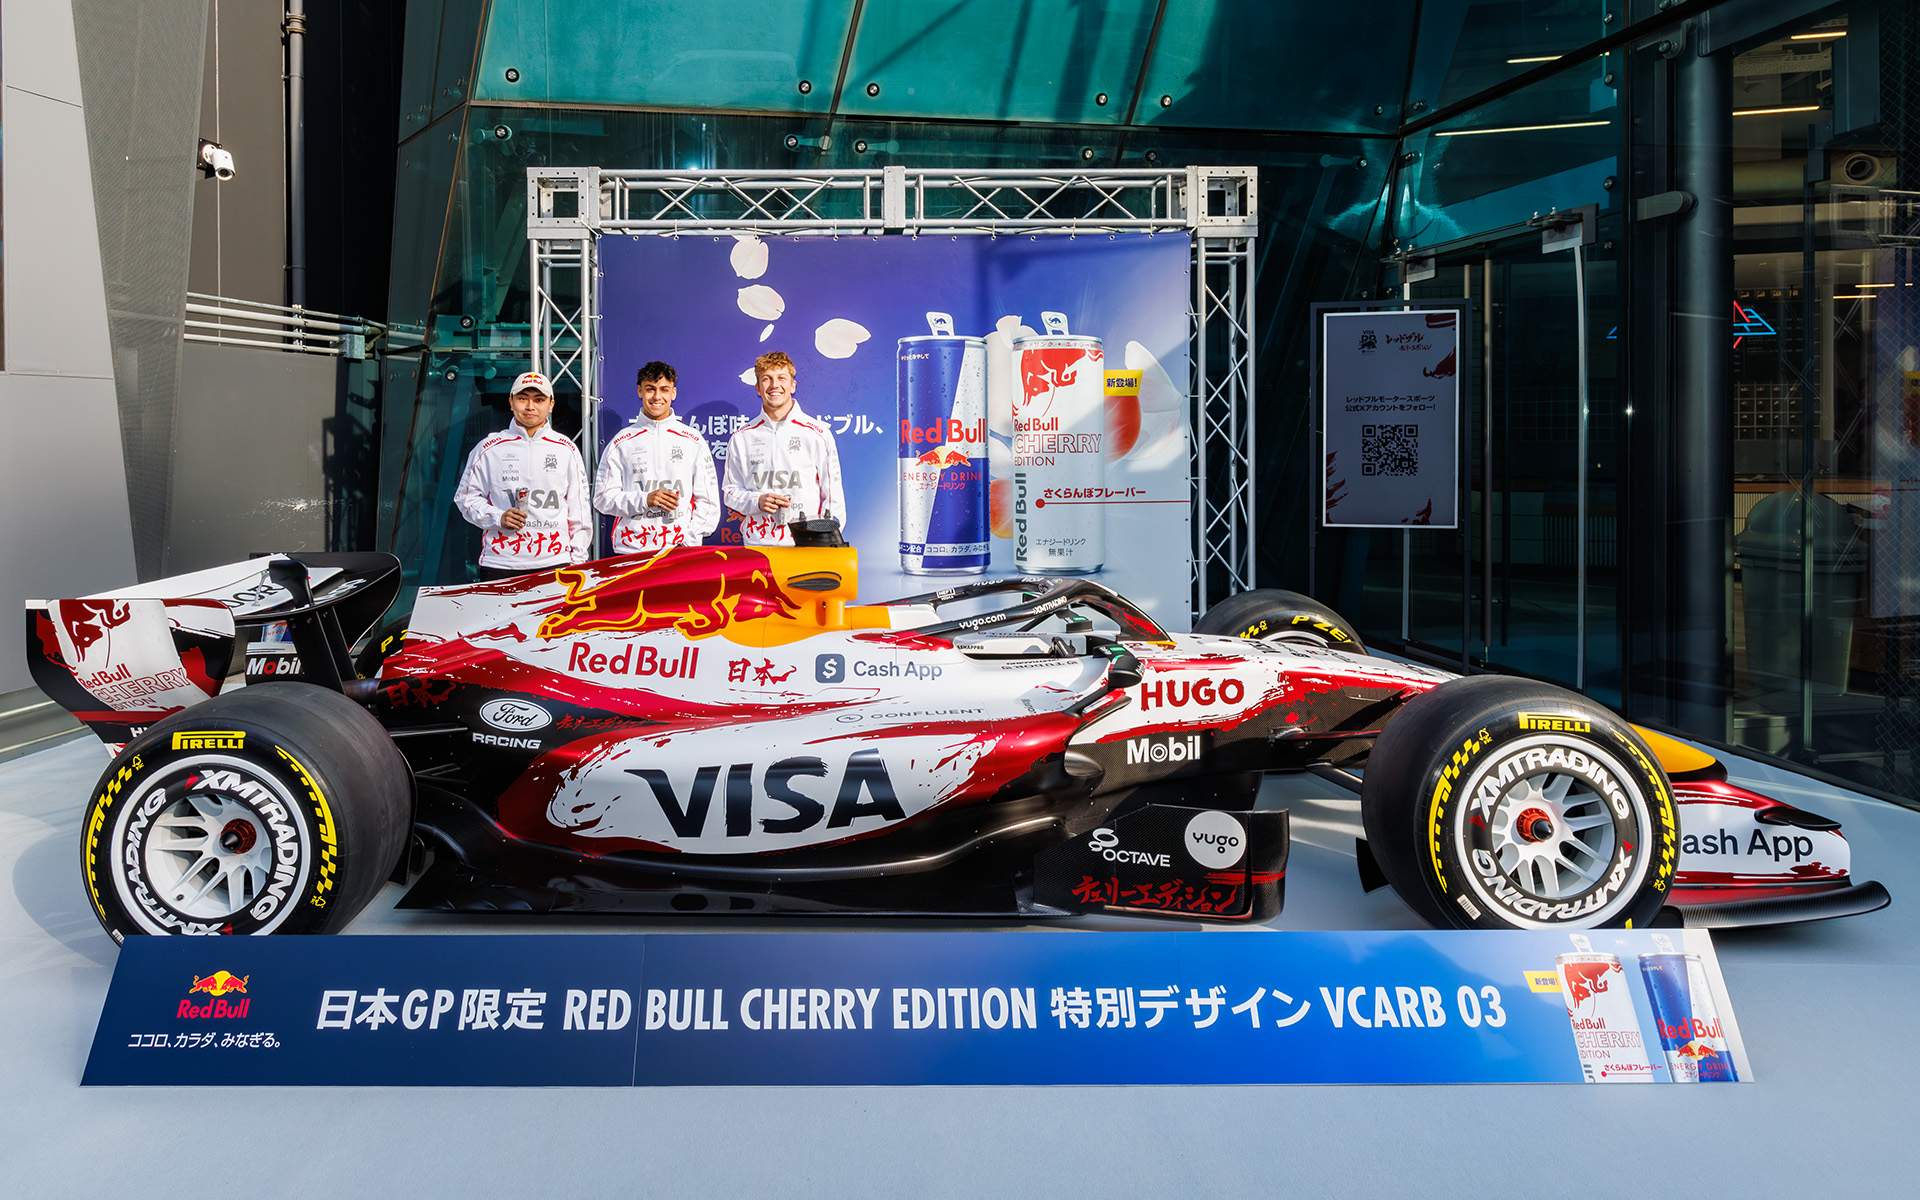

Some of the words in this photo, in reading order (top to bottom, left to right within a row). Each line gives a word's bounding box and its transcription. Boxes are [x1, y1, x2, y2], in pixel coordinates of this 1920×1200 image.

[1346, 395, 1435, 403] レッドブルモータースポーツ
[901, 418, 942, 443] Red
[947, 418, 986, 443] Bull
[1014, 418, 1031, 432] Red
[1033, 417, 1058, 431] Bull
[483, 436, 502, 449] HUGO
[559, 437, 576, 451] HUGO
[1014, 434, 1102, 453] CHERRY
[1014, 456, 1055, 466] EDITION
[753, 470, 803, 490] VISA
[903, 472, 946, 481] ENERGY
[951, 471, 983, 481] DRINK
[919, 482, 966, 490] エナジードリンク
[1015, 473, 1027, 515] Bull
[1043, 488, 1146, 499] さくらんぼフレーバー
[543, 519, 559, 528] App
[721, 528, 742, 543] Re
[1016, 518, 1027, 562] Red
[1036, 538, 1087, 546] エナジードリンク
[1048, 548, 1074, 557] 無果汁
[959, 613, 1007, 631] yugo.com
[246, 657, 301, 676] Mobil
[568, 641, 635, 674] Red
[635, 645, 700, 679] Bull
[97, 663, 132, 686] Bull
[728, 657, 798, 687] 日本
[853, 661, 900, 678] Cash
[905, 661, 943, 681] App
[92, 667, 191, 704] CHERRY
[1140, 678, 1246, 711] HUGO
[493, 703, 539, 727] Ford
[871, 708, 985, 720] CONFLUENT
[1518, 711, 1591, 733] PIRELLI
[171, 730, 247, 750] PIRELLI
[472, 732, 542, 750] RACING
[1127, 736, 1201, 765] Mobil
[623, 748, 907, 837] VISA
[1470, 748, 1630, 823] XMTRADING
[192, 769, 299, 921] XMTRADING
[1192, 831, 1239, 855] yugo
[1682, 828, 1744, 855] ash
[1747, 828, 1814, 862] App
[126, 788, 224, 936] XMTRADING
[1103, 849, 1171, 868] OCTAVE
[1472, 846, 1632, 920] XMTRADING
[1071, 875, 1238, 913] チェリーエディション
[177, 998, 214, 1019] Red
[214, 998, 250, 1019] Bull
[315, 987, 546, 1032] 日本GP限定
[563, 988, 633, 1032] RED
[645, 988, 729, 1032] BULL
[740, 987, 881, 1031] CHERRY
[894, 986, 1038, 1031] EDITION
[1050, 984, 1313, 1030] 特別デザイン
[1319, 985, 1447, 1029] VCARB
[1457, 984, 1508, 1028] 03
[1572, 1018, 1586, 1030] Red
[1585, 1017, 1606, 1029] Bull
[1657, 1017, 1694, 1039] Red
[1693, 1018, 1724, 1039] Bull
[128, 1031, 281, 1050] ココロ、カラダ、みなぎる。
[1576, 1031, 1642, 1048] CHERRY
[1579, 1050, 1611, 1059] EDITION
[1604, 1063, 1663, 1072] さくらんぼフレーバー
[1671, 1062, 1703, 1071] ENERGY
[1705, 1062, 1731, 1071] DRINK
